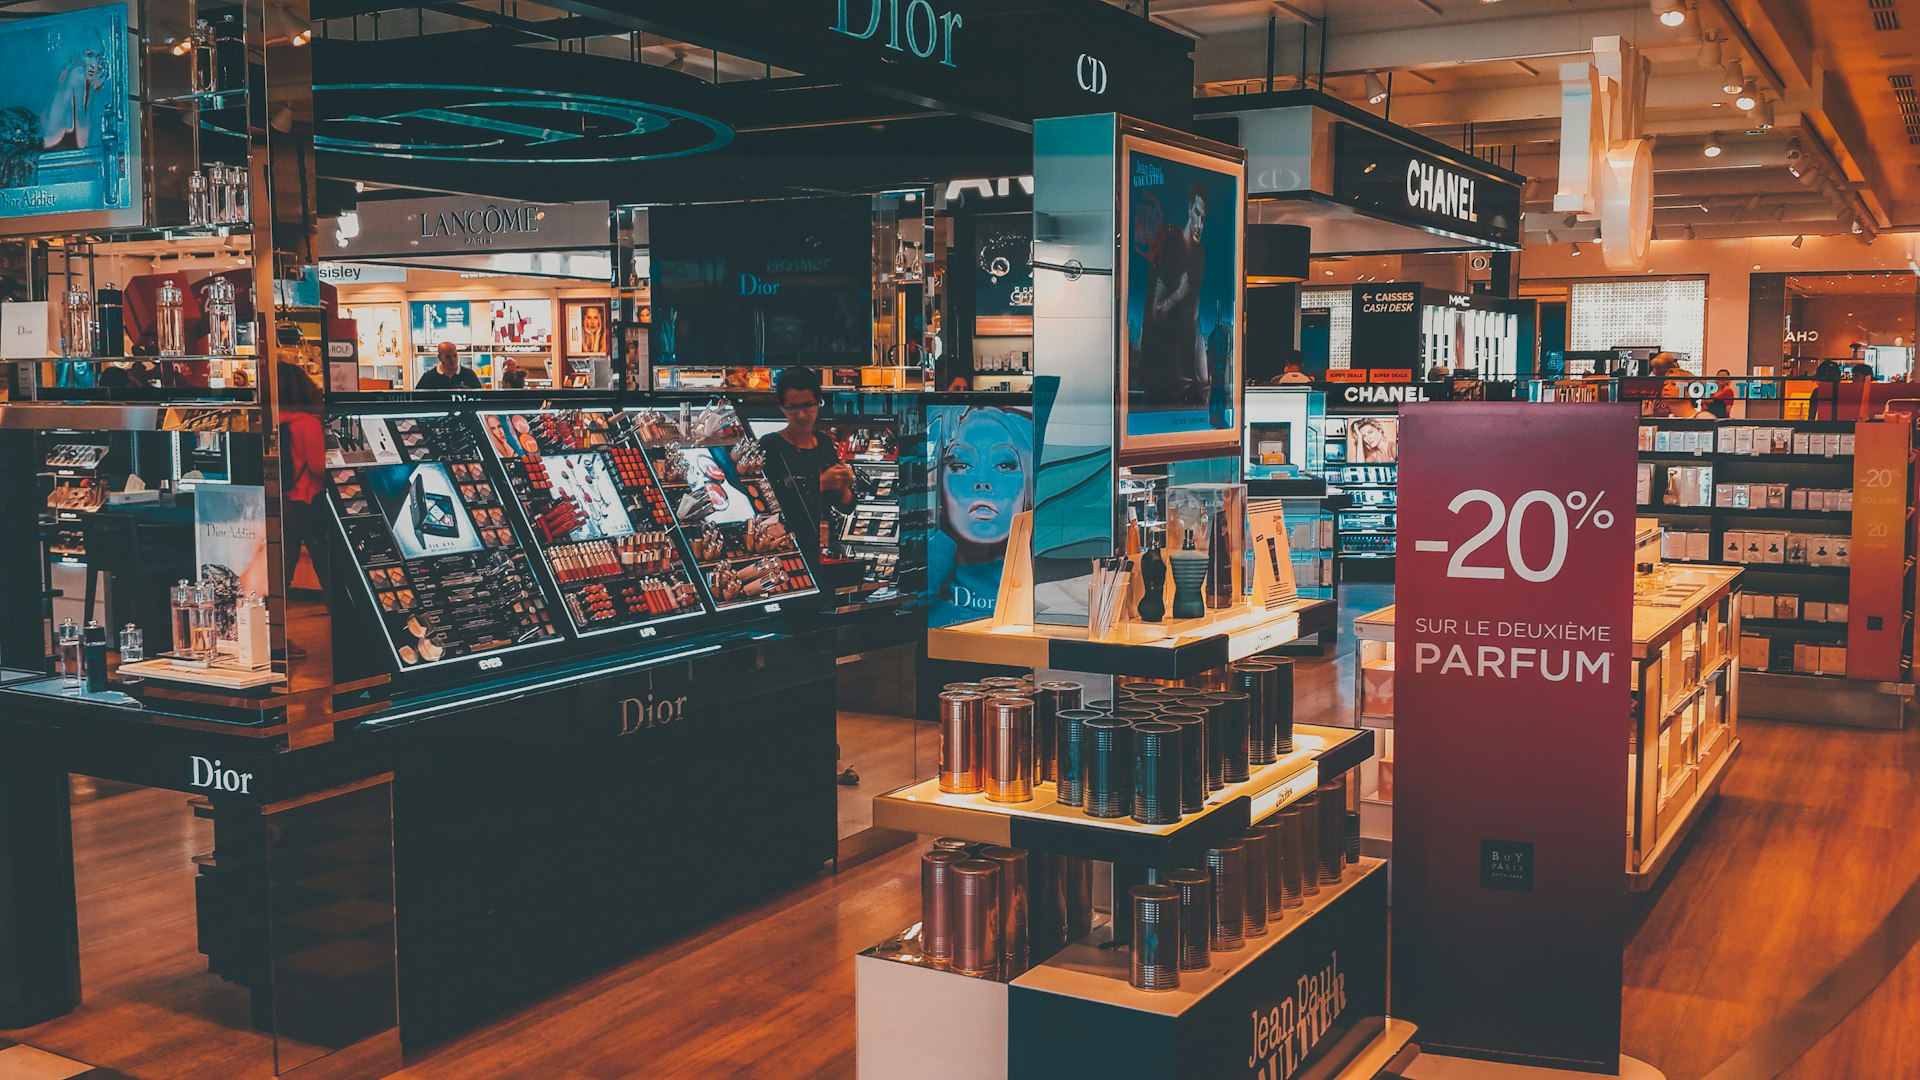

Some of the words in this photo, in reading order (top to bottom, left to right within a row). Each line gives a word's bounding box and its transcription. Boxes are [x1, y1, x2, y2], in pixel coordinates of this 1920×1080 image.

[829, 0, 963, 68] Dior
[21, 190, 56, 208] Addict
[1406, 159, 1478, 222] CHANEL
[421, 205, 539, 237] LANCÔME
[319, 265, 361, 280] sisley
[738, 273, 780, 295] Dior
[1363, 303, 1388, 313] CASH
[1388, 302, 1415, 313] DESK
[1375, 292, 1415, 302] CAISSES
[1448, 294, 1471, 307] MAC
[17, 325, 33, 336] Dior
[1344, 386, 1430, 402] CHANEL
[1675, 381, 1719, 399] TOP
[1735, 382, 1777, 399] TEN
[206, 523, 226, 537] Dior
[1415, 489, 1615, 583] -20%
[953, 586, 995, 609] Dior
[1415, 617, 1457, 634] SUR
[1465, 620, 1491, 636] LE
[1497, 621, 1611, 642] DEUXIÈME
[1415, 642, 1611, 684] PARFUM
[618, 694, 688, 737] Dior
[190, 755, 254, 794] Dior
[1249, 1008, 1295, 1069] Jean
